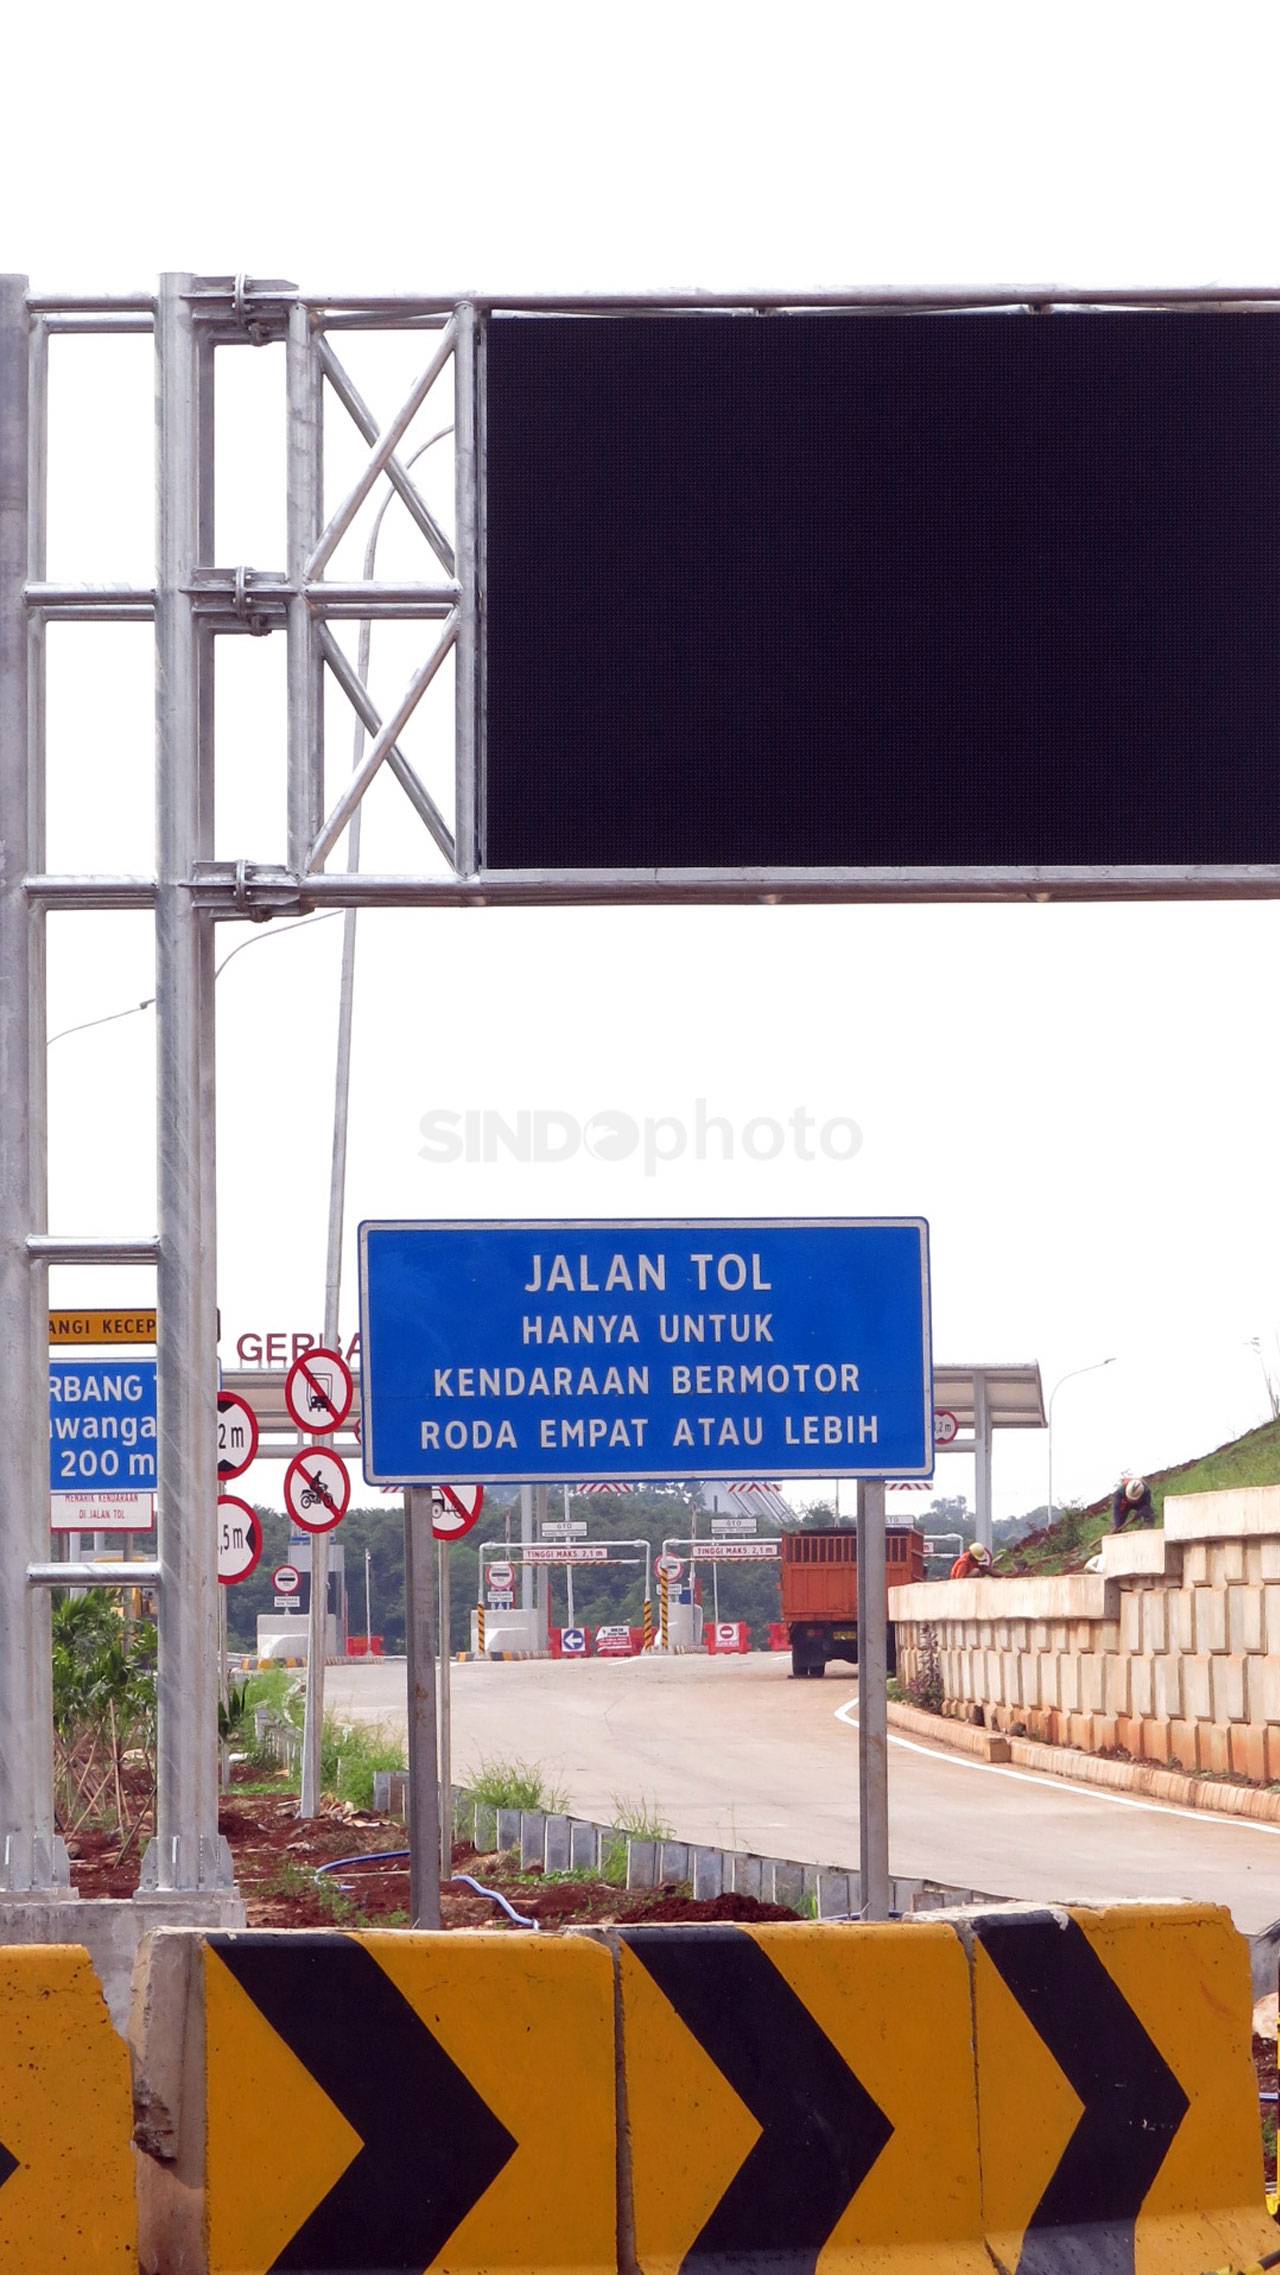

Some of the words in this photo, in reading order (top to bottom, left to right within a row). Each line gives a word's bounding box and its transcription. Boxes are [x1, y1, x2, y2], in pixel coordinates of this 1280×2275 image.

[524, 1254, 666, 1293] JALAN
[690, 1254, 772, 1291] TOL
[102, 1318, 156, 1334] KECEP
[522, 1315, 639, 1344] HANYA
[659, 1314, 774, 1343] UNTUK
[433, 1366, 650, 1397] KENDARAAN
[671, 1363, 860, 1394] BERMOTOR
[49, 1415, 156, 1446] wanga
[231, 1426, 244, 1448] m
[420, 1420, 518, 1449] RODA
[540, 1418, 649, 1448] EMPAT
[673, 1417, 764, 1446] ATAU
[785, 1416, 879, 1444] LEBIH
[61, 1449, 119, 1477] 200
[129, 1453, 155, 1475] m
[89, 1509, 110, 1519] JALAN
[113, 1508, 125, 1519] TOL
[697, 1547, 724, 1555] TINGGI
